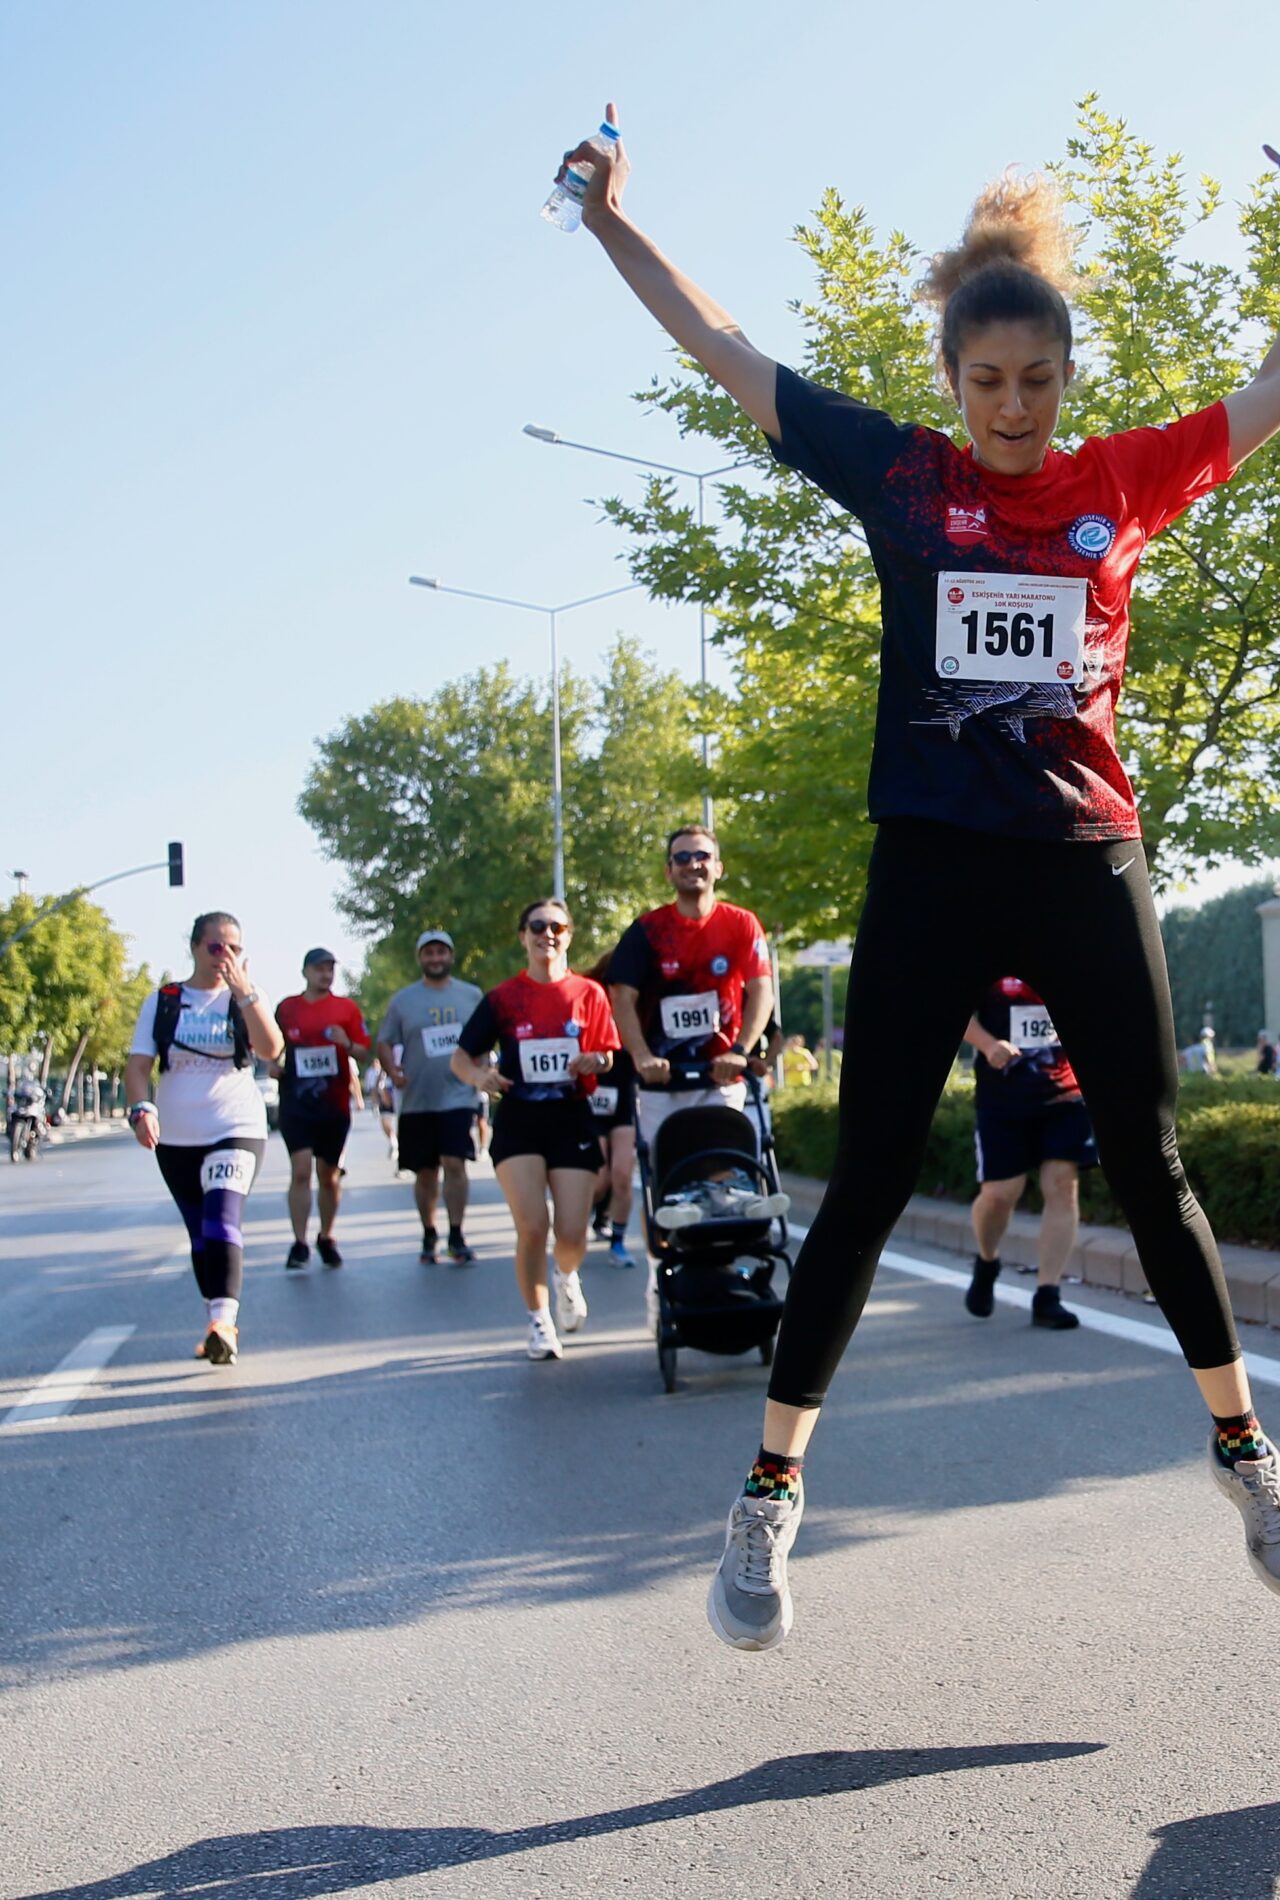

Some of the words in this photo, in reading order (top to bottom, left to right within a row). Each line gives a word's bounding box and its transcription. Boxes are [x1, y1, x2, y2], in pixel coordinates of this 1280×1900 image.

[972, 591, 1004, 599] ESKİŞEHİR
[961, 610, 1054, 658] 1561
[672, 1008, 710, 1029] 1991
[530, 1053, 570, 1072] 1617
[208, 1163, 243, 1181] 1205
